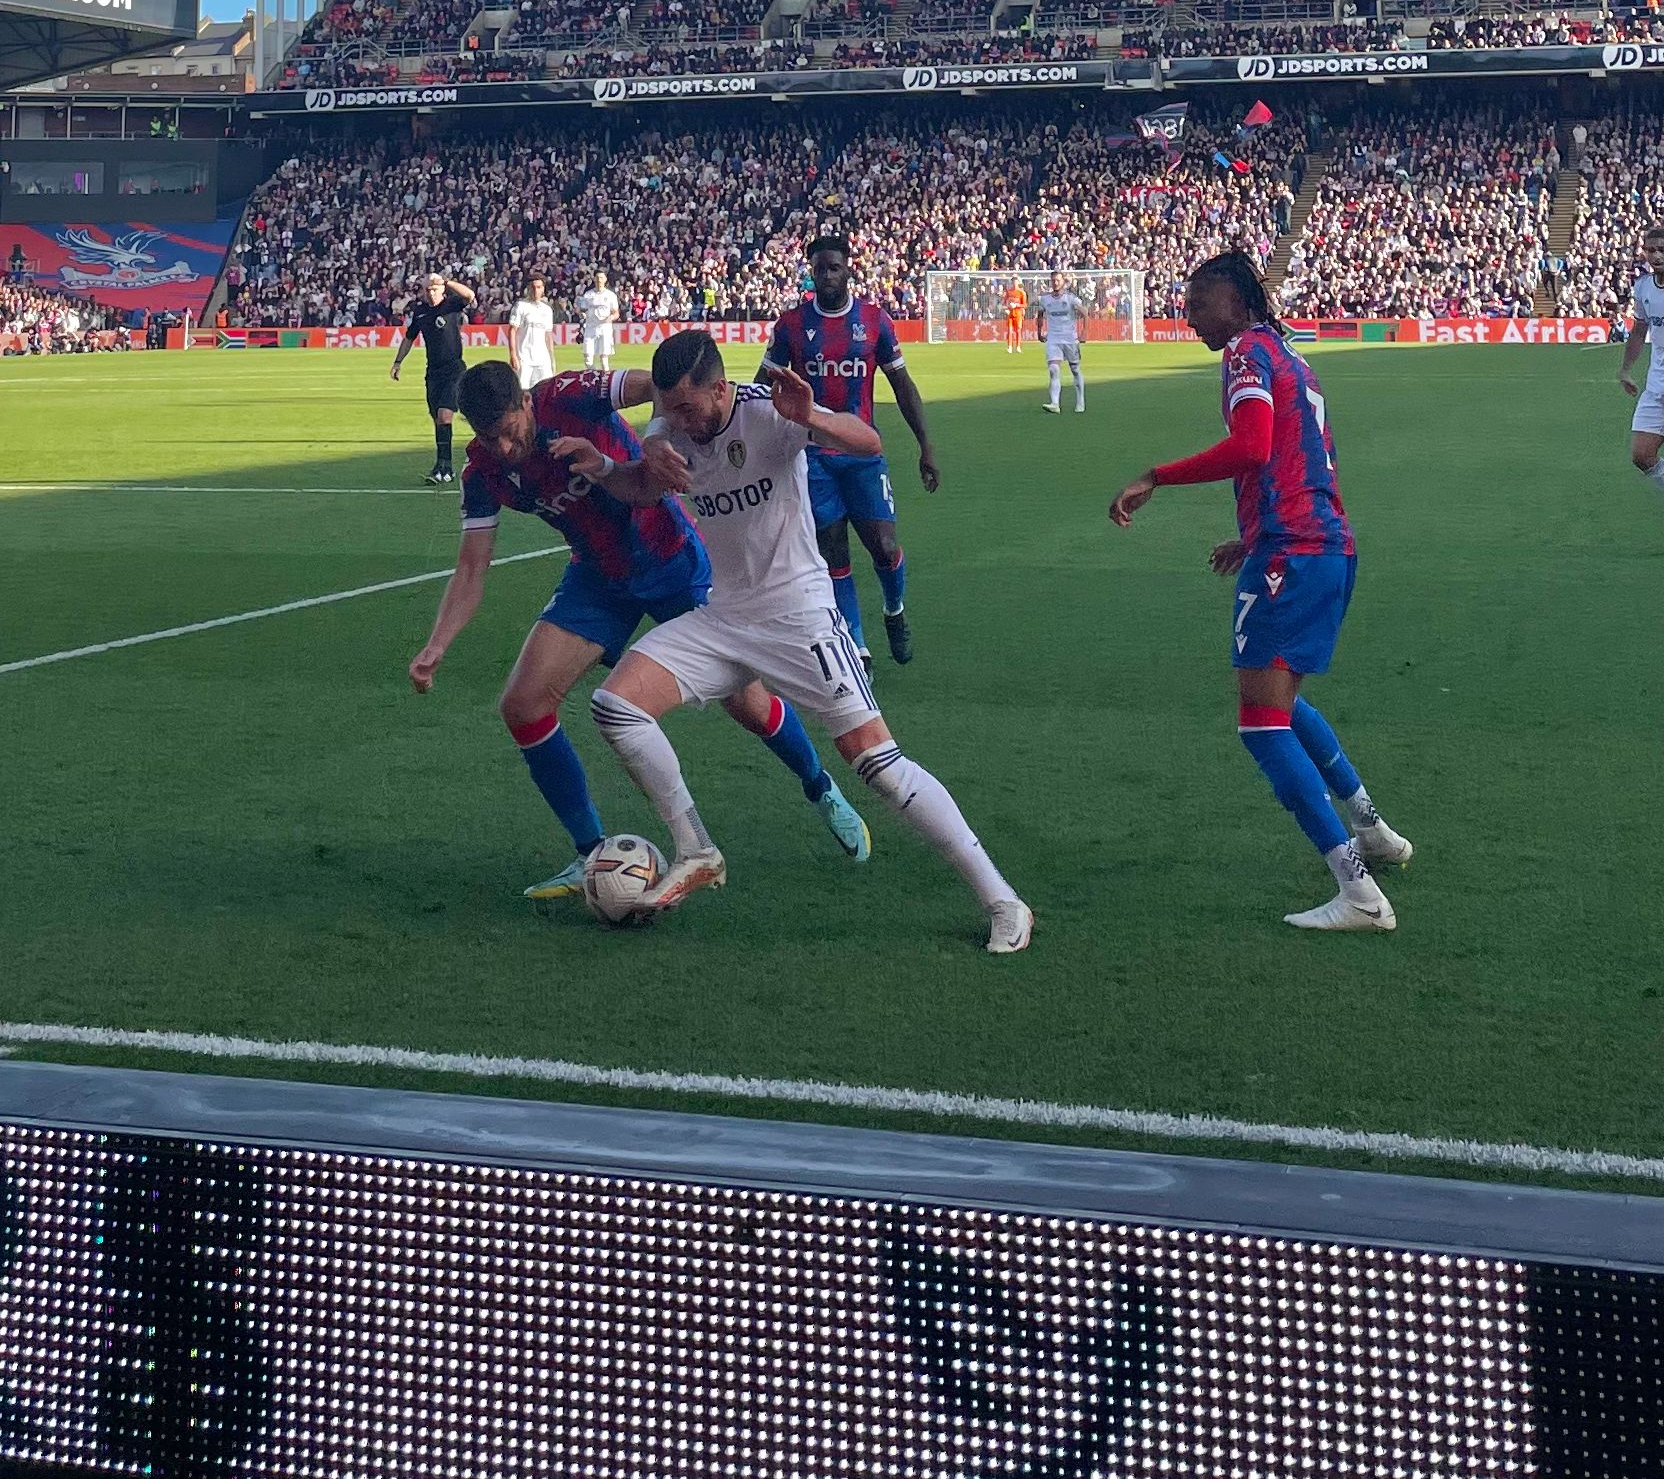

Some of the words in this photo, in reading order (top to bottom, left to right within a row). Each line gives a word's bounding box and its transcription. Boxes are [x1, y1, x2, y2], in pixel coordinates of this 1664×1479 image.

[1277, 55, 1428, 74] JDSPORTS.COM
[939, 67, 1077, 84] JDSPORTS.COM
[628, 77, 756, 95] JDSPORTS.COM
[337, 89, 457, 106] JDSPORTS.COM
[1152, 329, 1201, 341] mukur
[805, 352, 868, 378] cinch
[692, 477, 773, 517] SBOTOP
[1235, 591, 1258, 633] 7
[810, 640, 848, 682] 11
